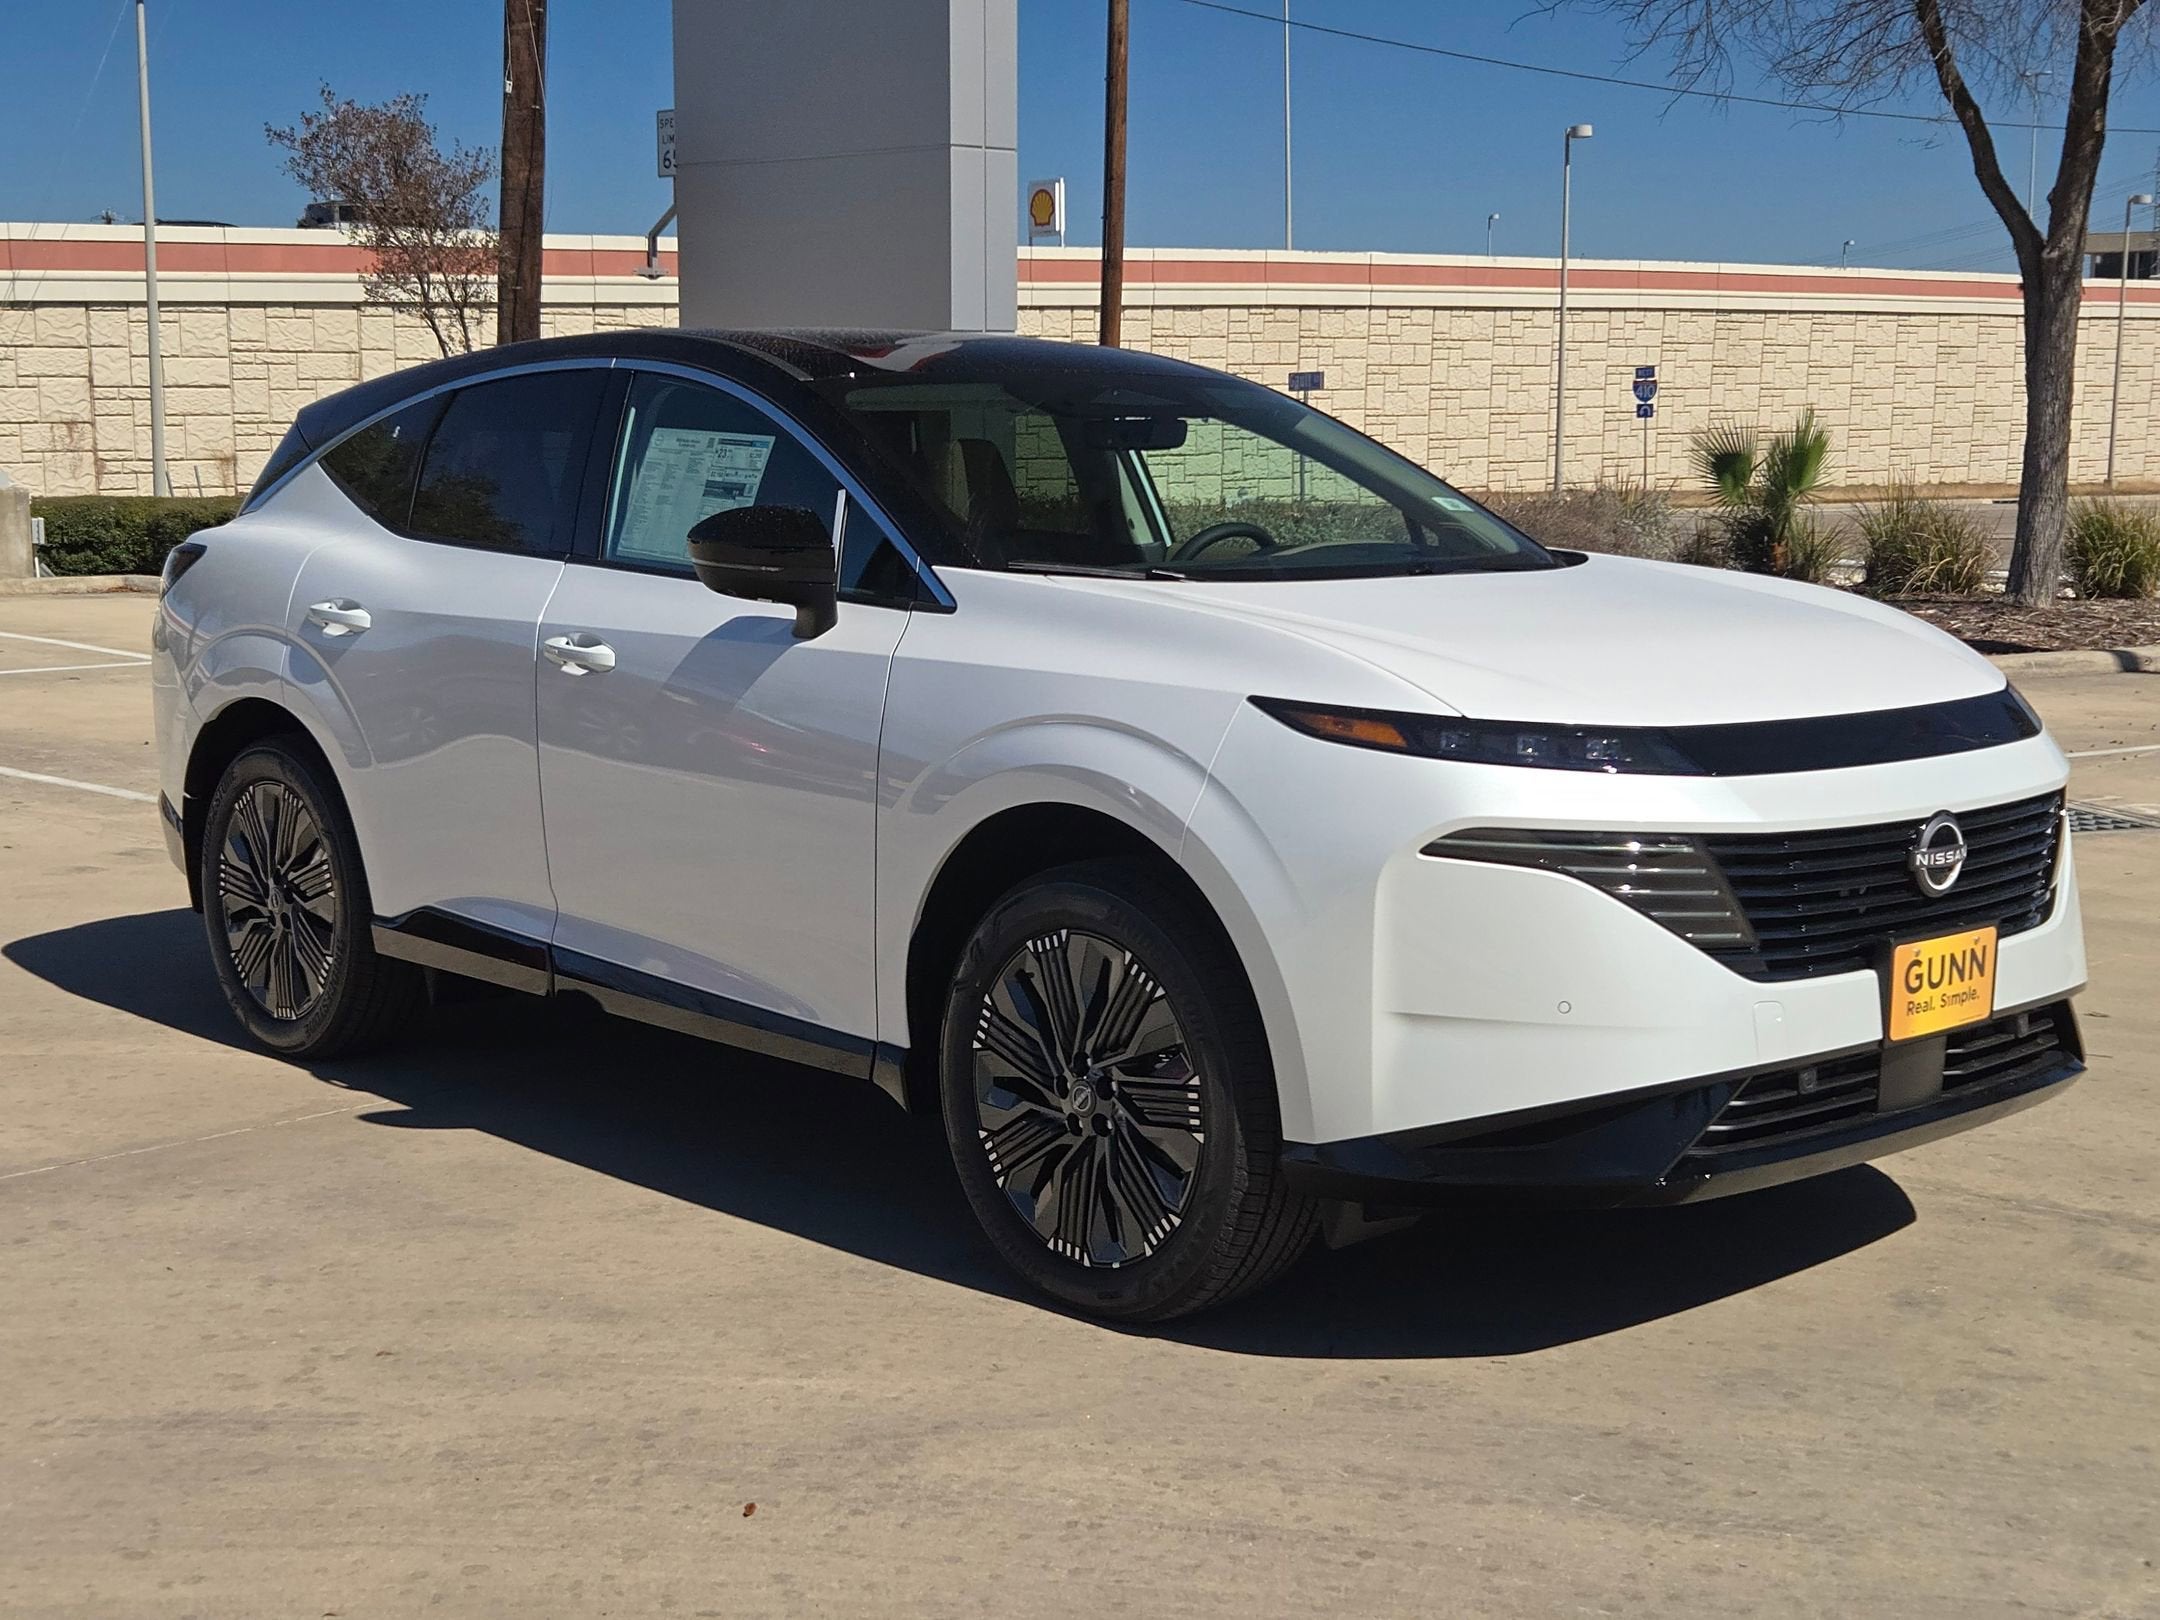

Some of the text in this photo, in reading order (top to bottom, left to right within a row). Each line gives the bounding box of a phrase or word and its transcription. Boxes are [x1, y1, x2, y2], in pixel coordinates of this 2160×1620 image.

[1635, 384, 1655, 398] 410
[1915, 846, 1967, 866] NISSAN
[1904, 945, 1987, 995] GUNN
[1906, 986, 1980, 1016] Real. Simple.
